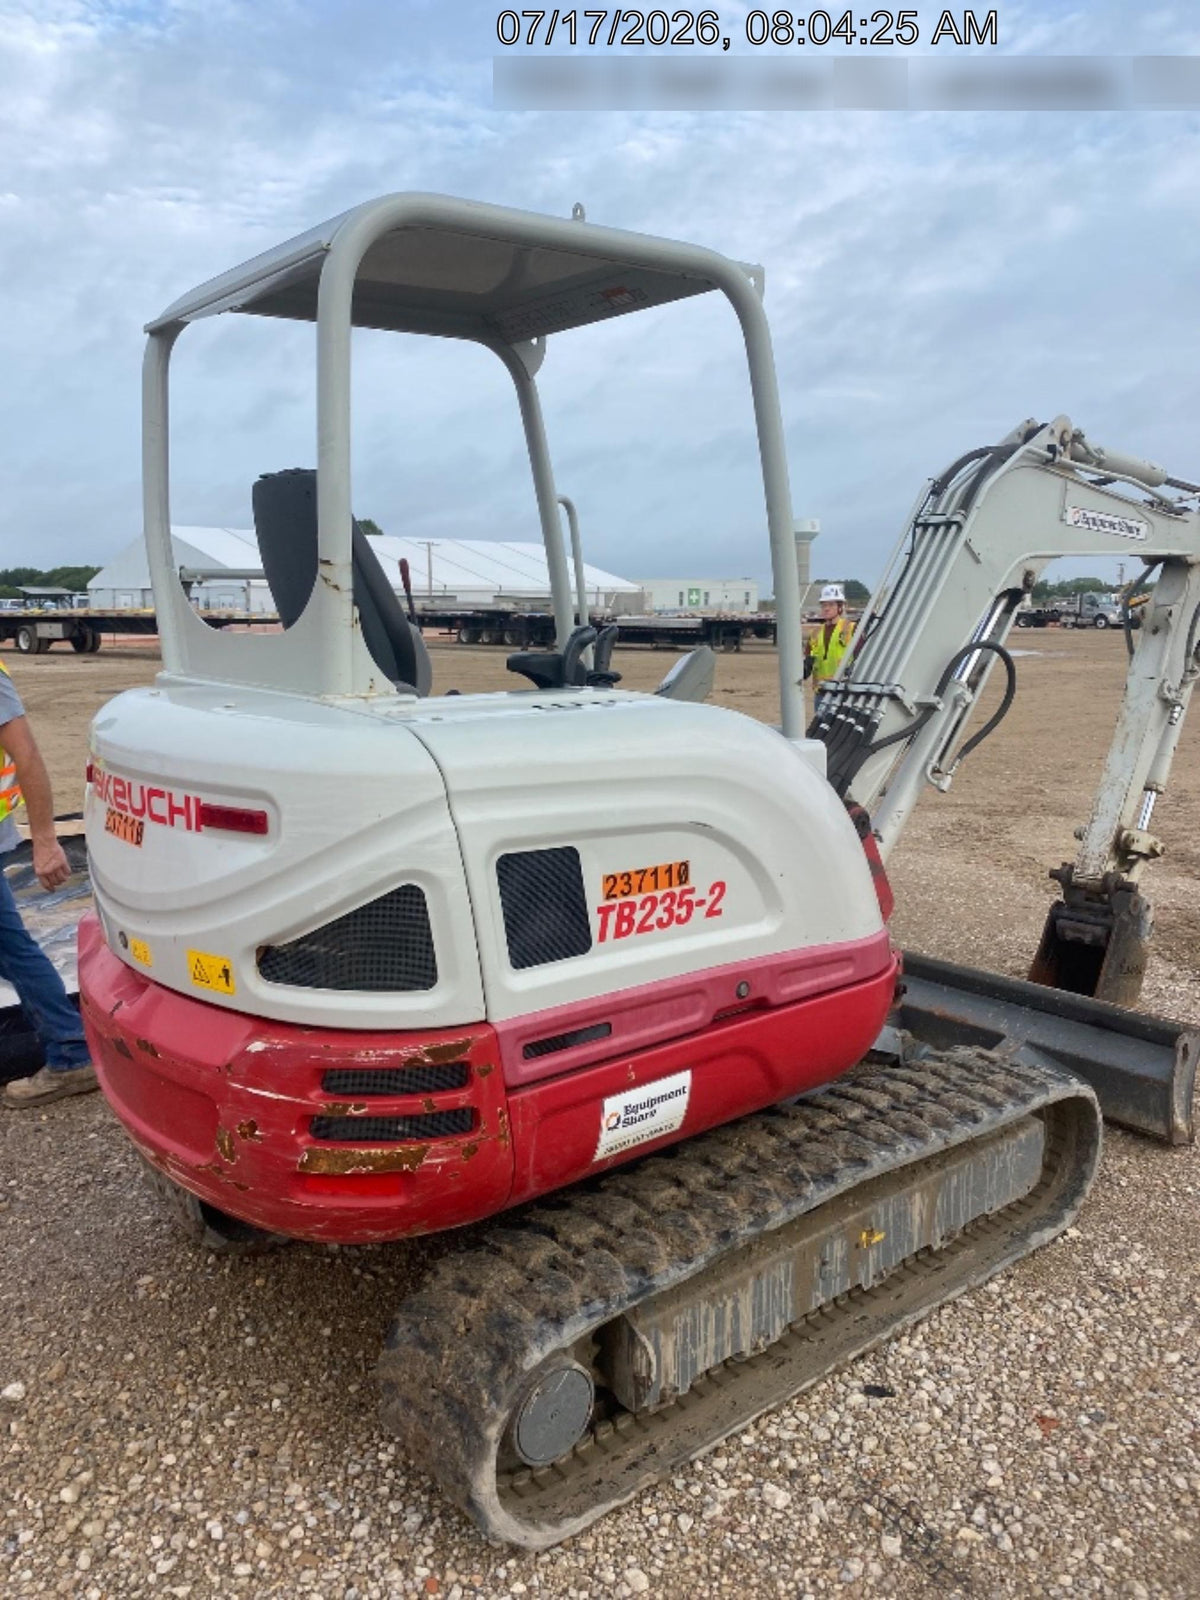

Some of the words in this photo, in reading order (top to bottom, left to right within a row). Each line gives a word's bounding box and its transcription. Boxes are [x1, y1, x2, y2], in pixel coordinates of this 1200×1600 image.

[604, 861, 689, 900] 237110
[597, 881, 726, 943] TB235-2
[624, 1085, 687, 1116] Equipment
[621, 1109, 657, 1128] Share
